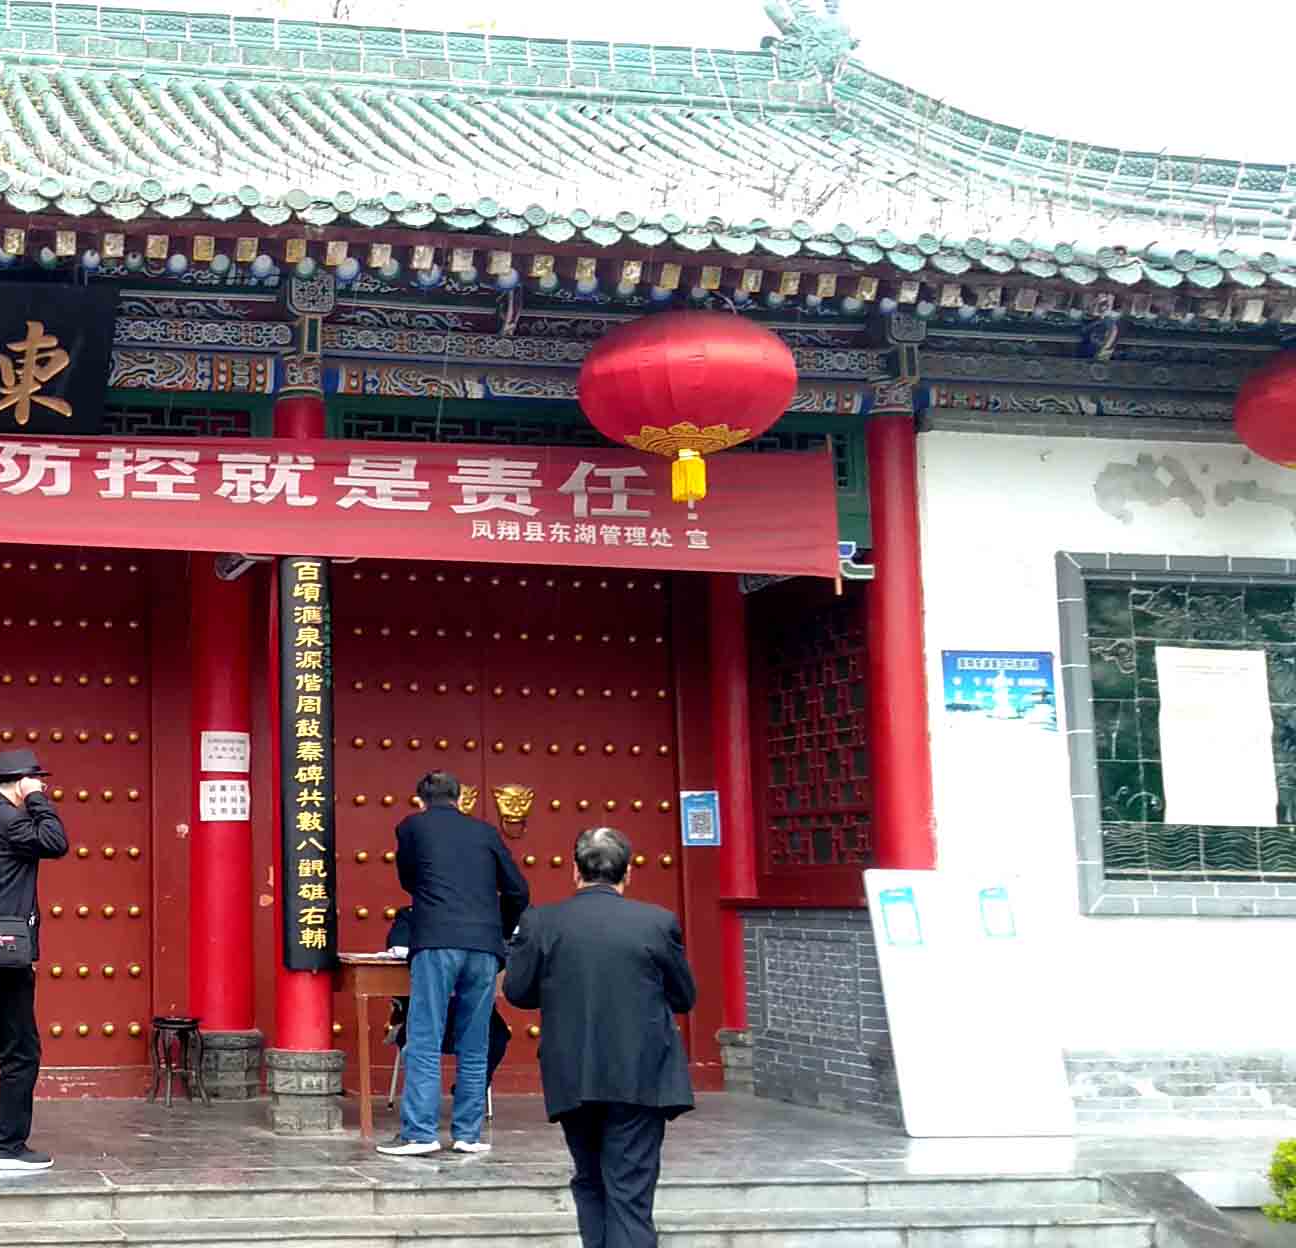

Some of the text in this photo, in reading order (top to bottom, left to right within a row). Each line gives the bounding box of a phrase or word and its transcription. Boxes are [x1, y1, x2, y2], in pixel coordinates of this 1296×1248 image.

[470, 519, 712, 550] 凤翔县东湖管理处 宣
